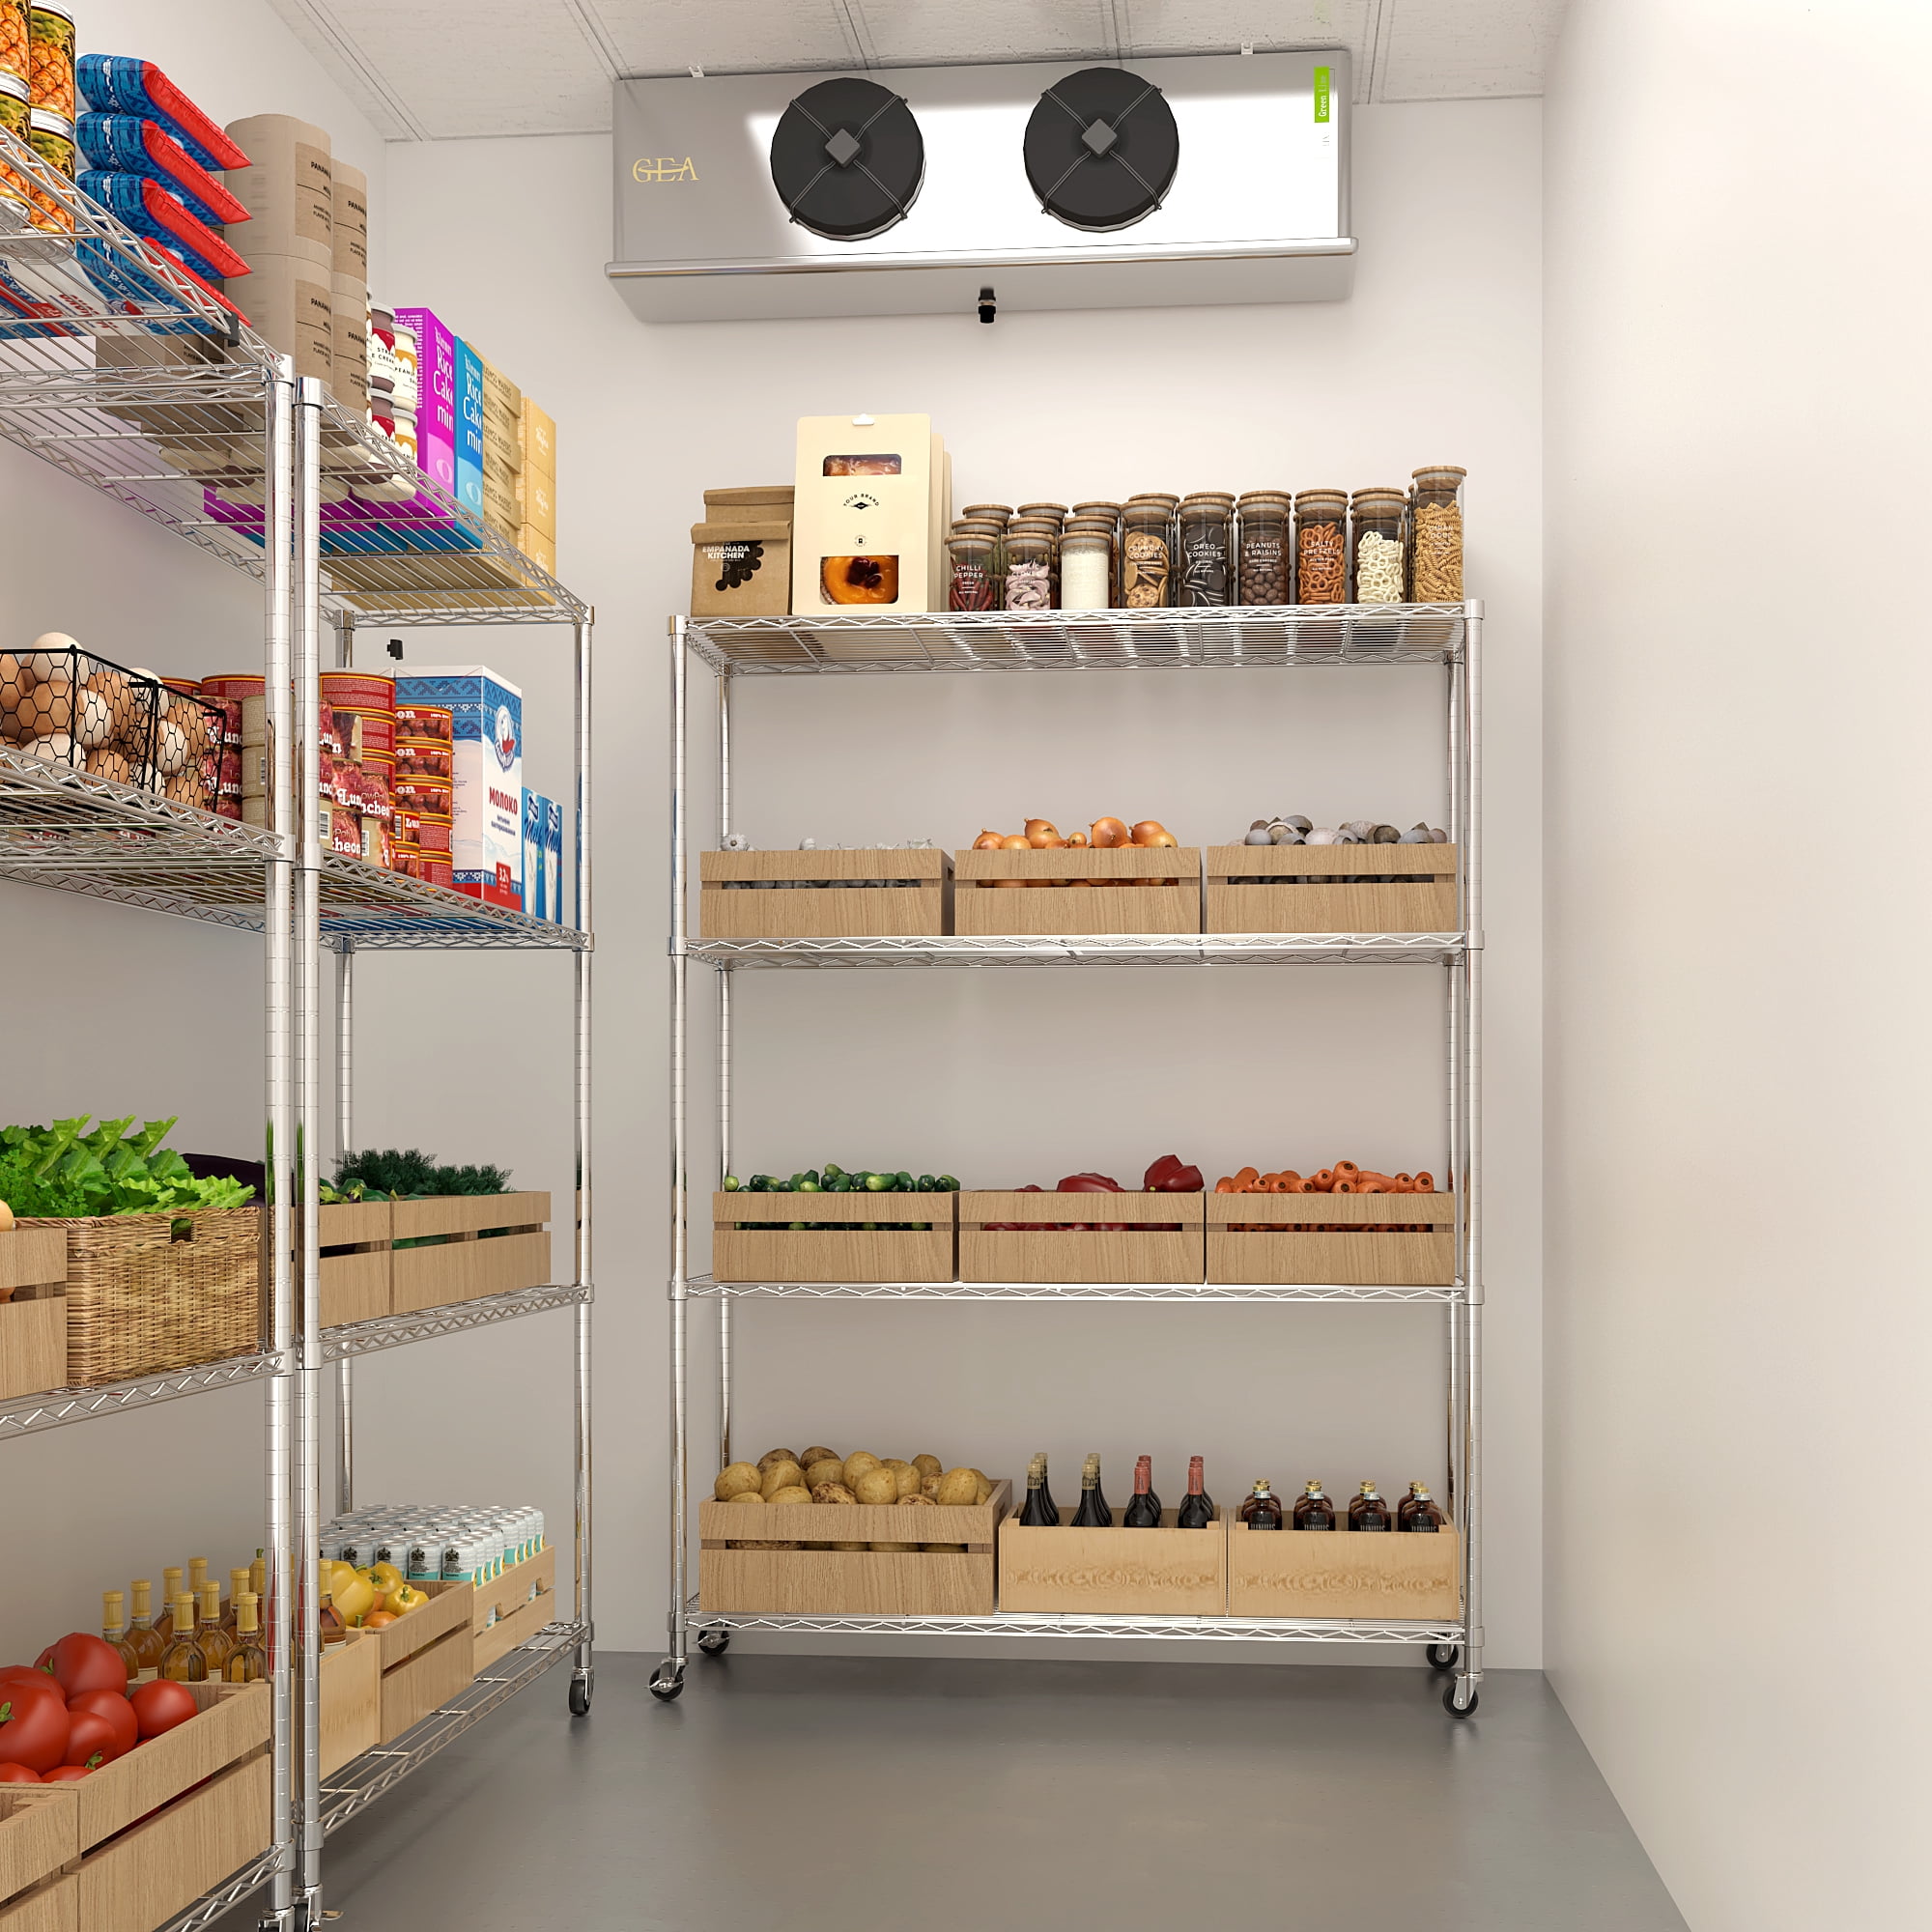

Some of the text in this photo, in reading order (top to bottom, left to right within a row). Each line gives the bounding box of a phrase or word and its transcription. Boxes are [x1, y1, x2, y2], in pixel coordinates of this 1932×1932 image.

[1318, 95, 1327, 117] Green
[633, 156, 700, 183] GEA
[843, 493, 880, 506] YOUR BRAND
[1128, 544, 1164, 553] CRUNCHY
[489, 785, 518, 815] МОЛОКО
